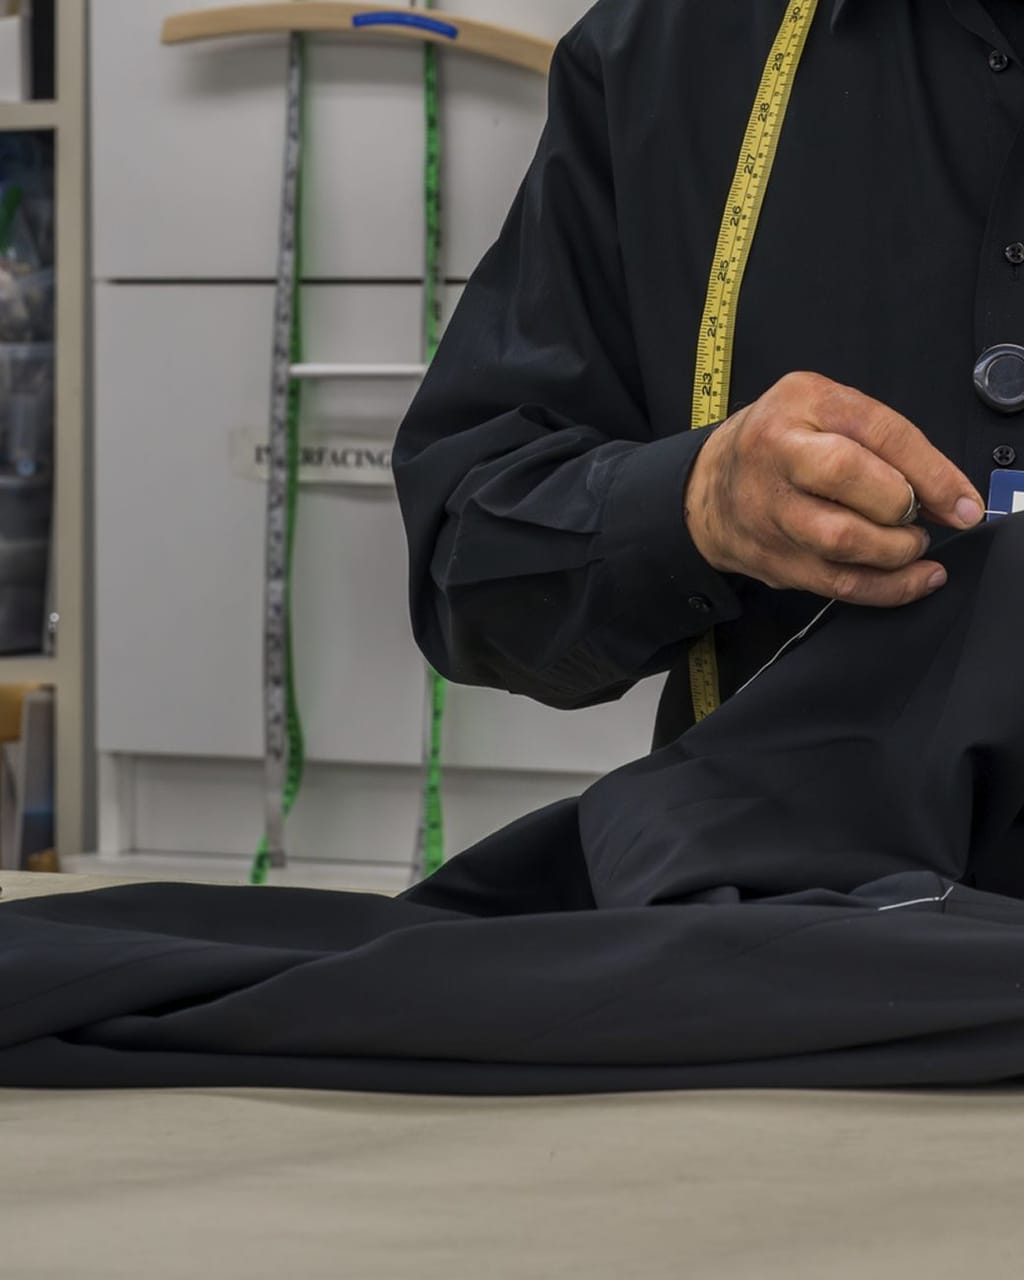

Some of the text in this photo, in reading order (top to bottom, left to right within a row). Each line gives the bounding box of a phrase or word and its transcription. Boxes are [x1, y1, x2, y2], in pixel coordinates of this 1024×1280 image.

[789, 6, 800, 23] 30
[771, 52, 785, 72] 29
[758, 102, 770, 122] 28
[744, 153, 756, 174] 27
[730, 206, 741, 226] 26
[717, 260, 729, 281] 25
[707, 316, 717, 337] 24
[702, 372, 712, 396] 23
